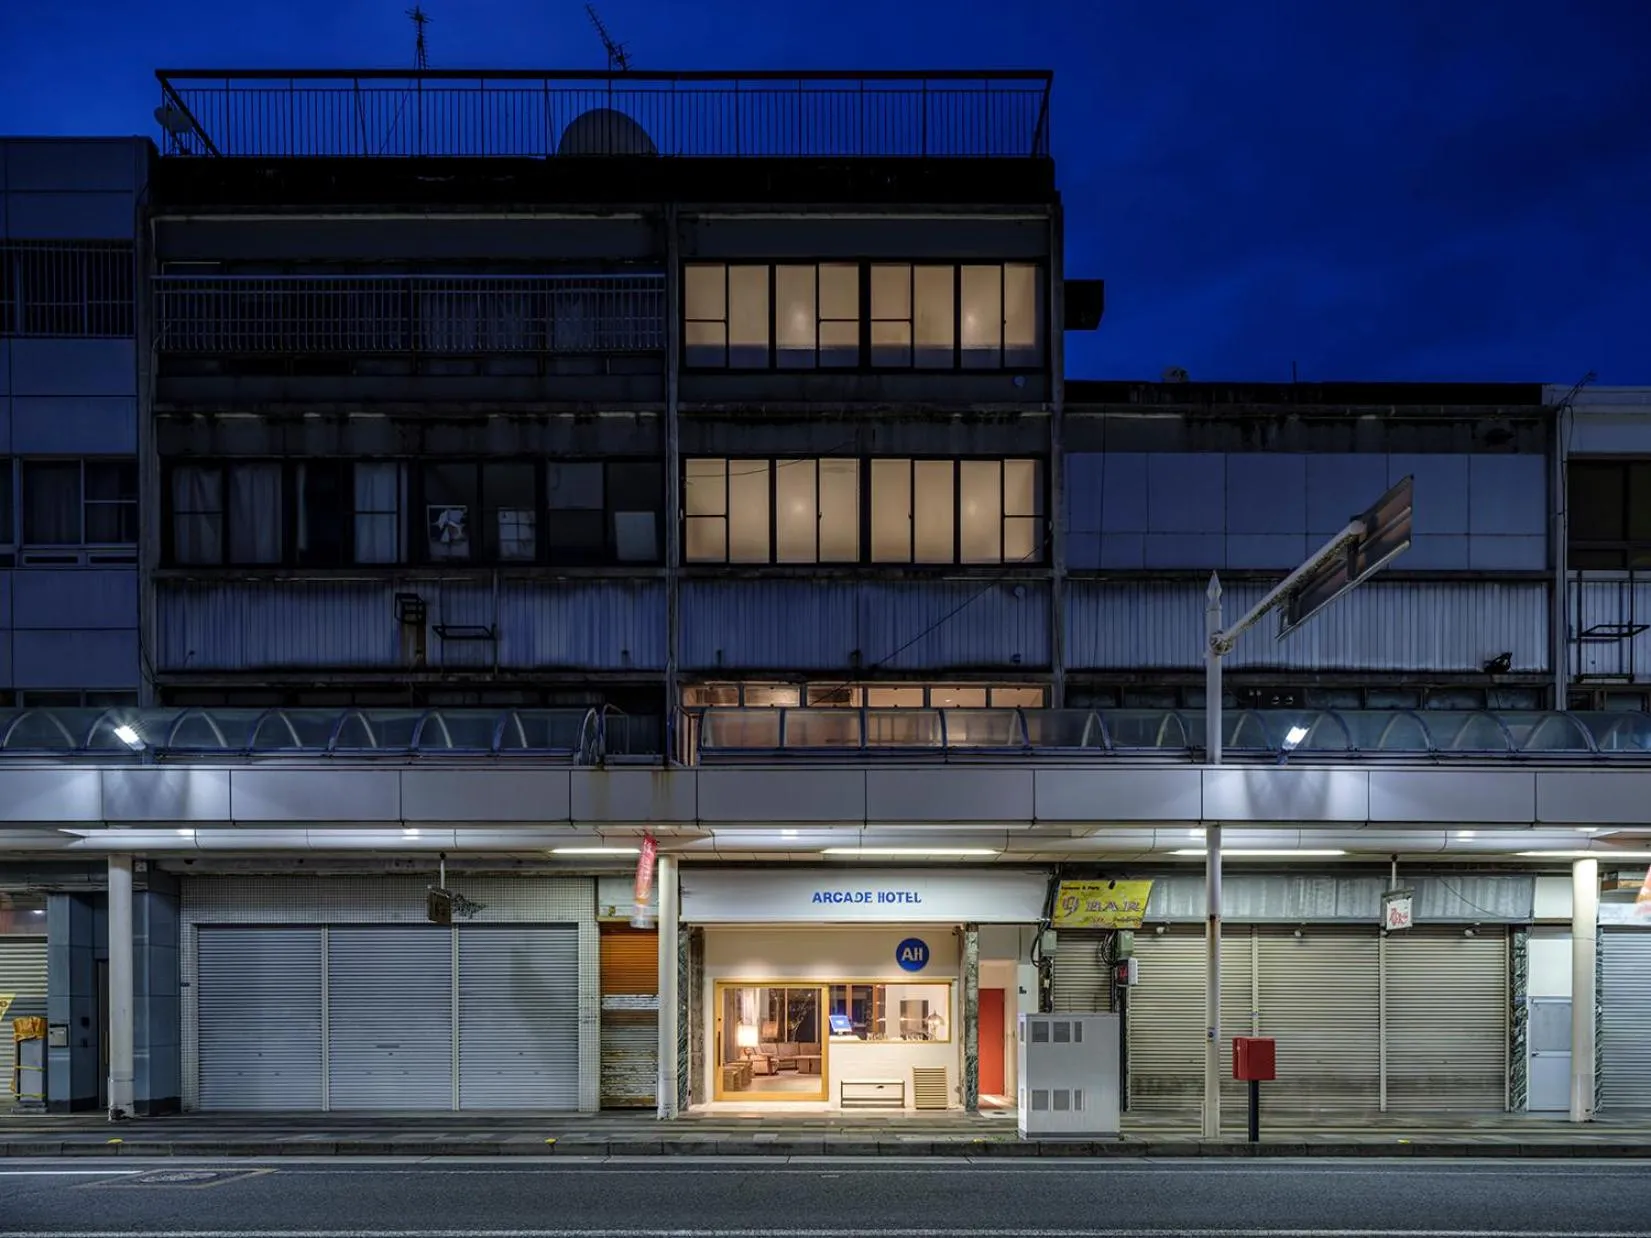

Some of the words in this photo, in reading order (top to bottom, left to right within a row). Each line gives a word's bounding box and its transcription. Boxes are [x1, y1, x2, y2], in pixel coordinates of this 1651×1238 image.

[812, 891, 873, 904] ARCADE
[877, 891, 922, 904] HOTEL
[1085, 899, 1141, 912] BAR
